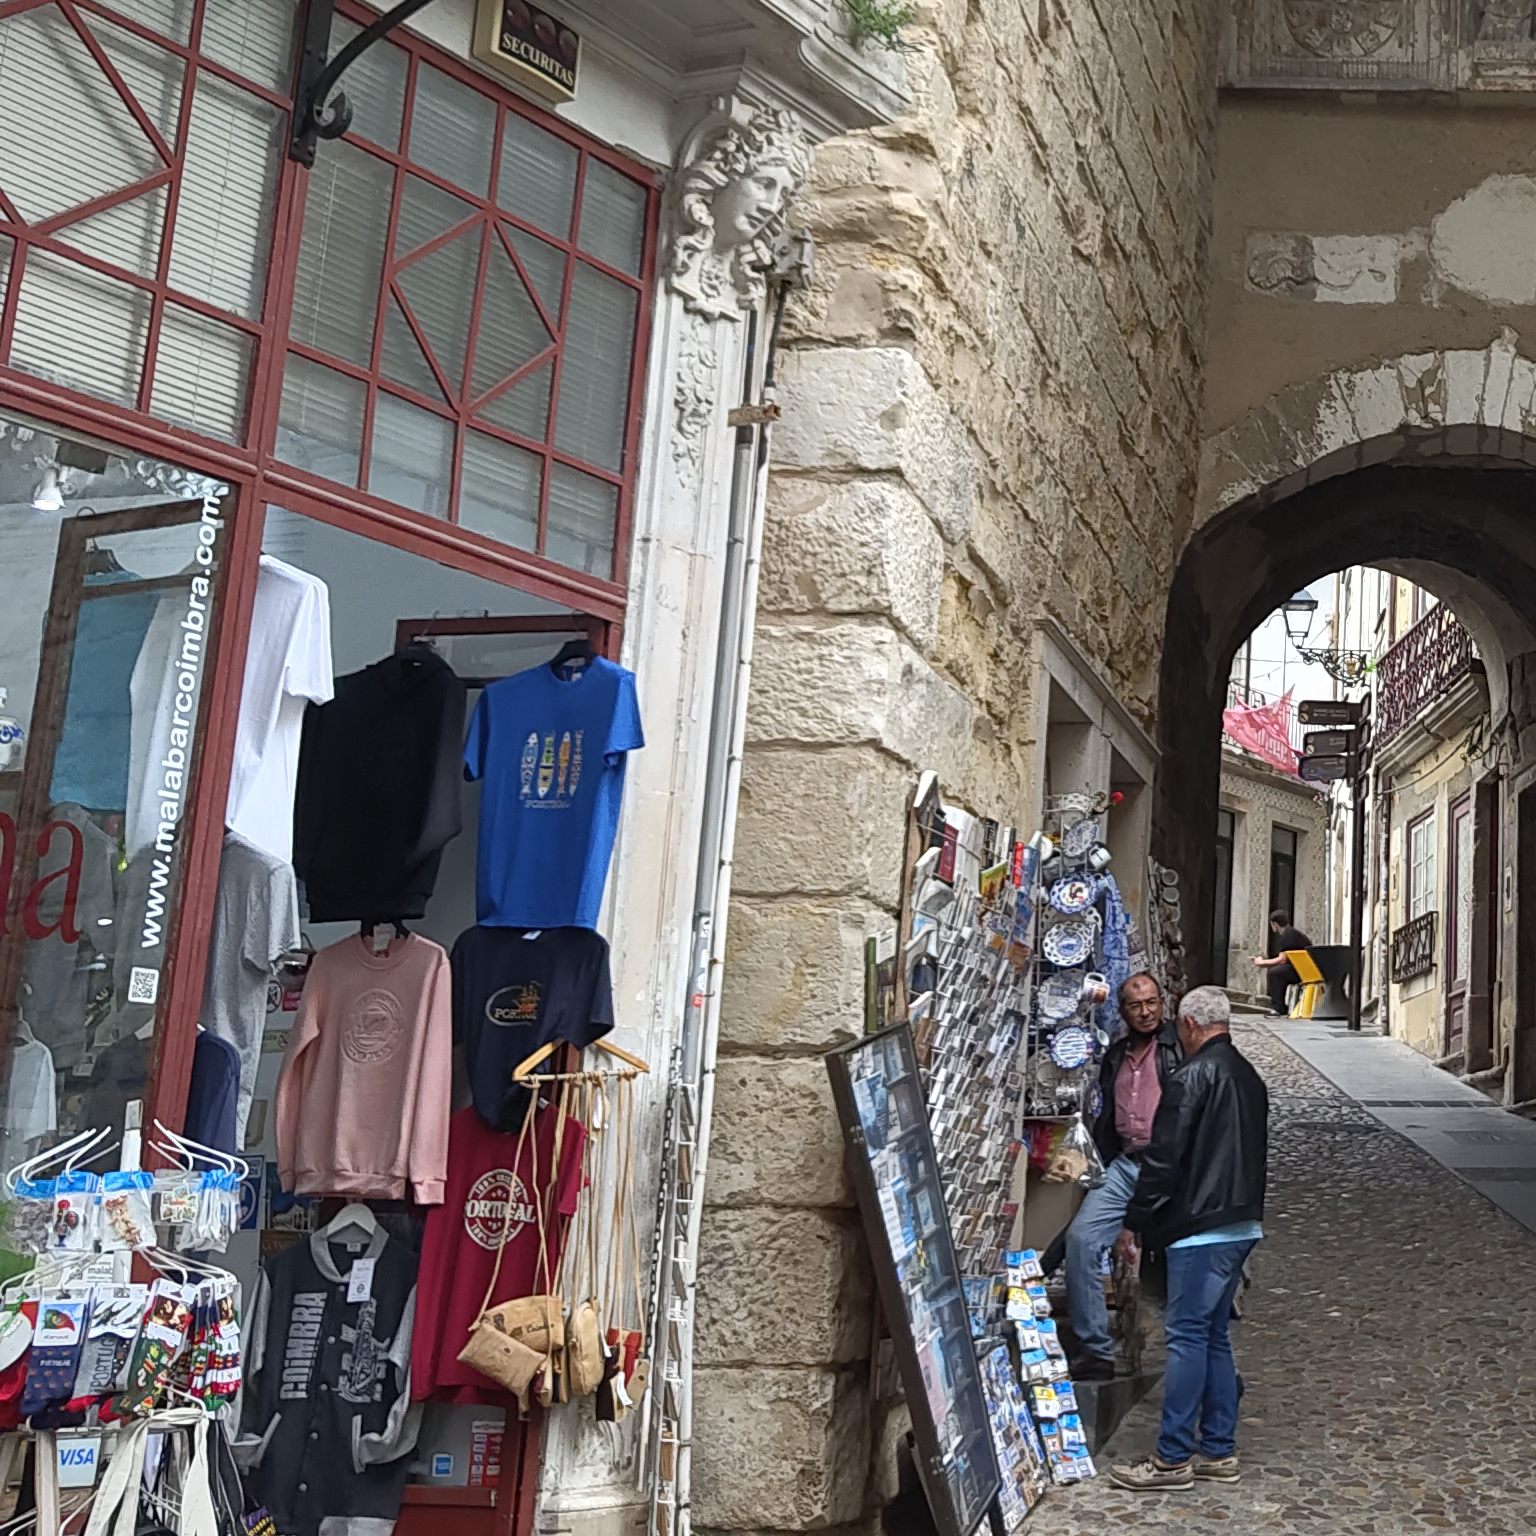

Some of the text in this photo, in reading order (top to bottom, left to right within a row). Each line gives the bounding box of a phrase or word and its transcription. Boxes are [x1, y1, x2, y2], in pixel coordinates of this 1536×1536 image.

[502, 32, 574, 86] SECURITAS
[141, 495, 221, 949] www.malabarcoimbra.com
[279, 1291, 329, 1401] COIMBRA
[59, 1448, 95, 1466] VISA
